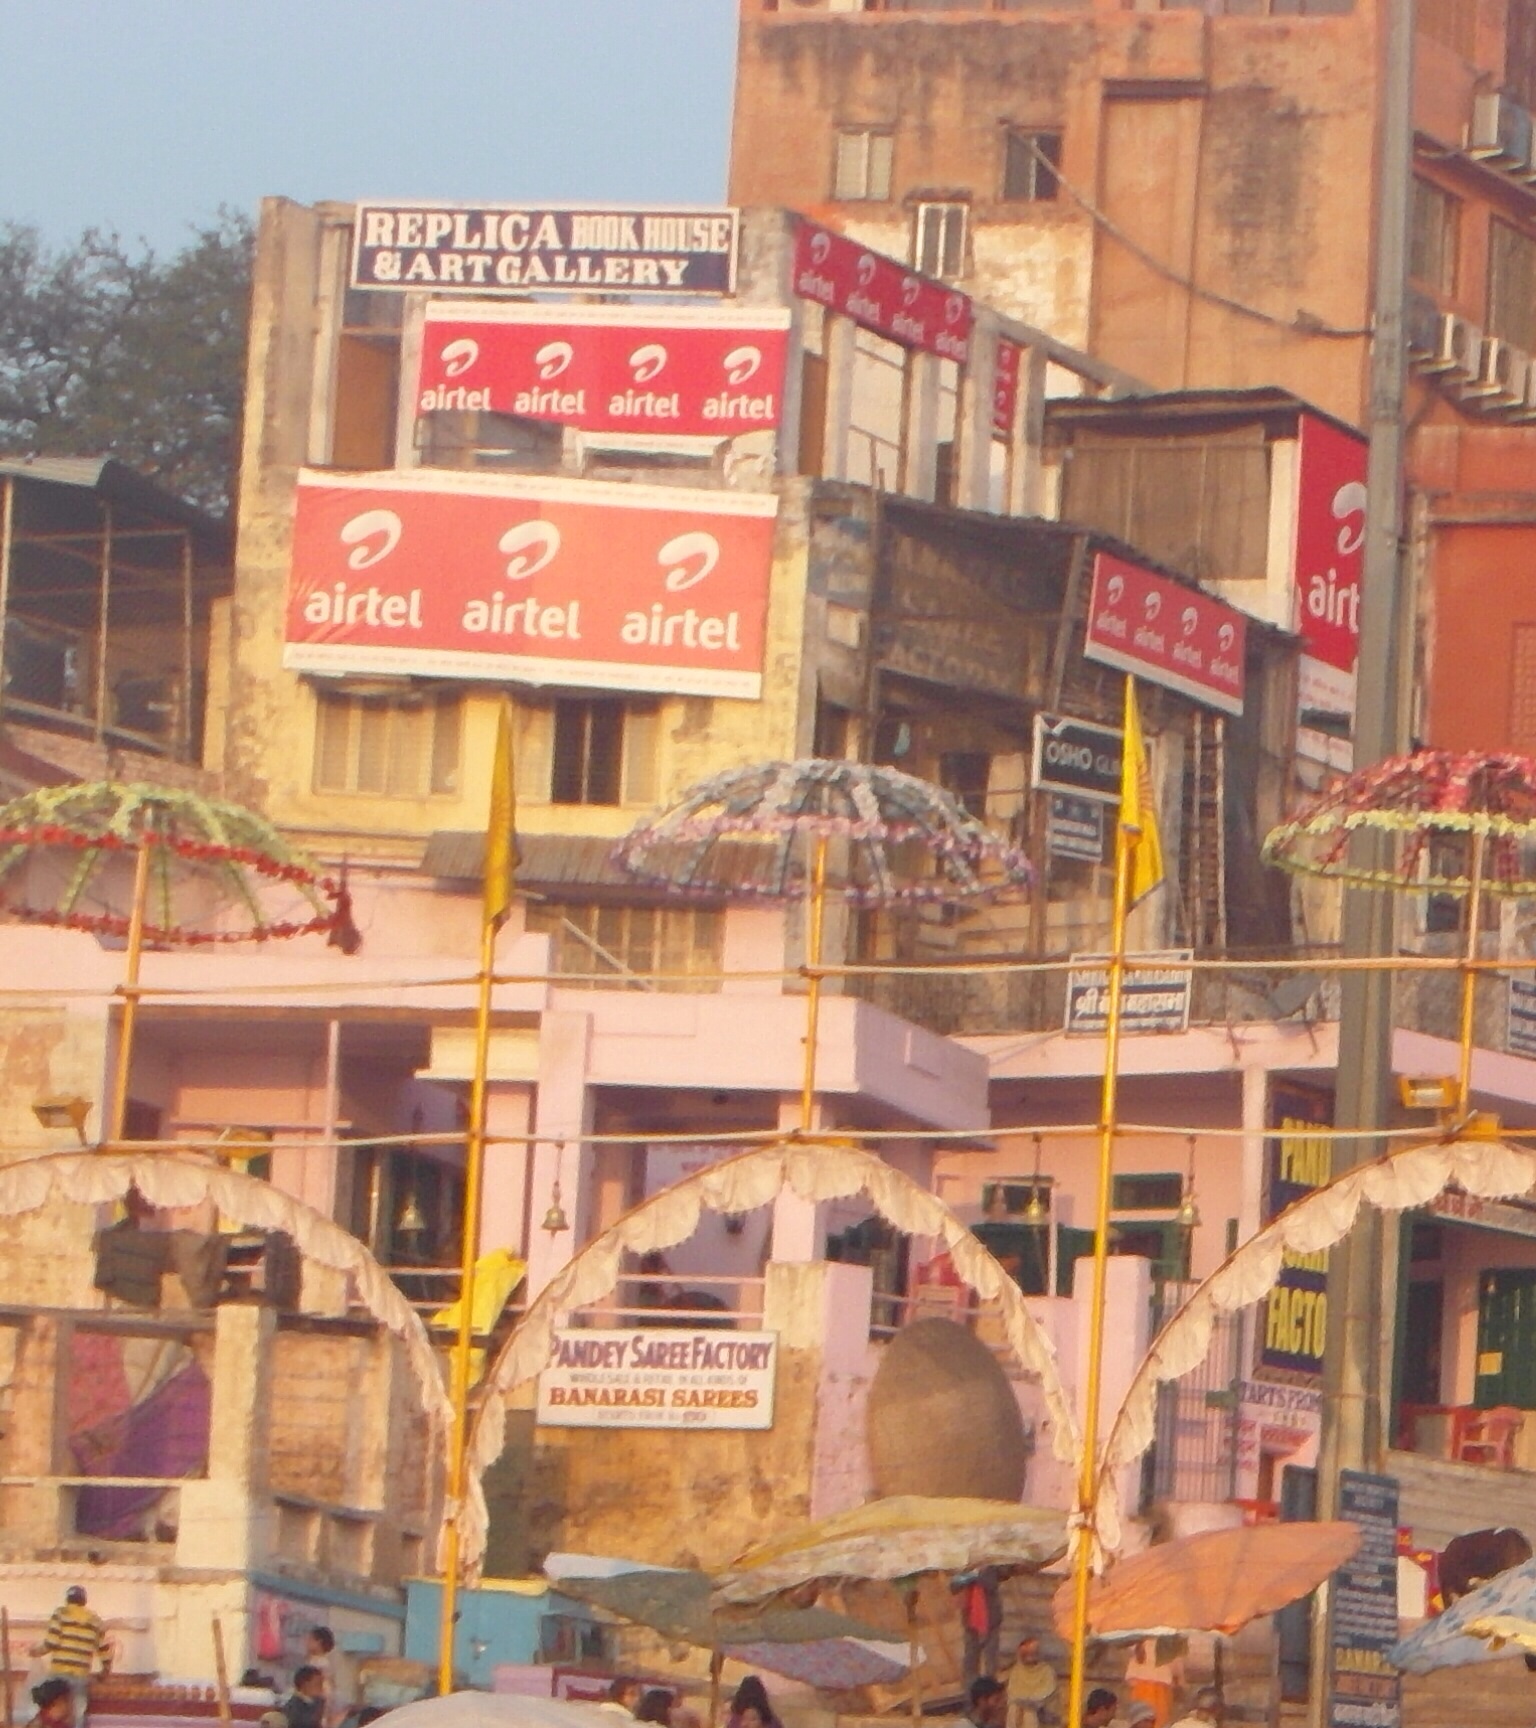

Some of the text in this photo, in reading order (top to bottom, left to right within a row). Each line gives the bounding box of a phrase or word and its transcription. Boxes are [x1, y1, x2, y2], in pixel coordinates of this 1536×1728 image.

[364, 212, 732, 254] REPLICA BOOK HOUSE
[373, 252, 690, 287] & ART GALLERY
[420, 383, 774, 420] airtel airtel airtel airtel
[303, 581, 741, 651] airtel airtel airtel
[1308, 567, 1361, 634] airt
[1046, 740, 1093, 771] OSHO
[1265, 1286, 1327, 1359] FACTO
[549, 1332, 774, 1371] PANDEY SAREE FACTORY
[549, 1387, 758, 1409] BANARASI SAREES
